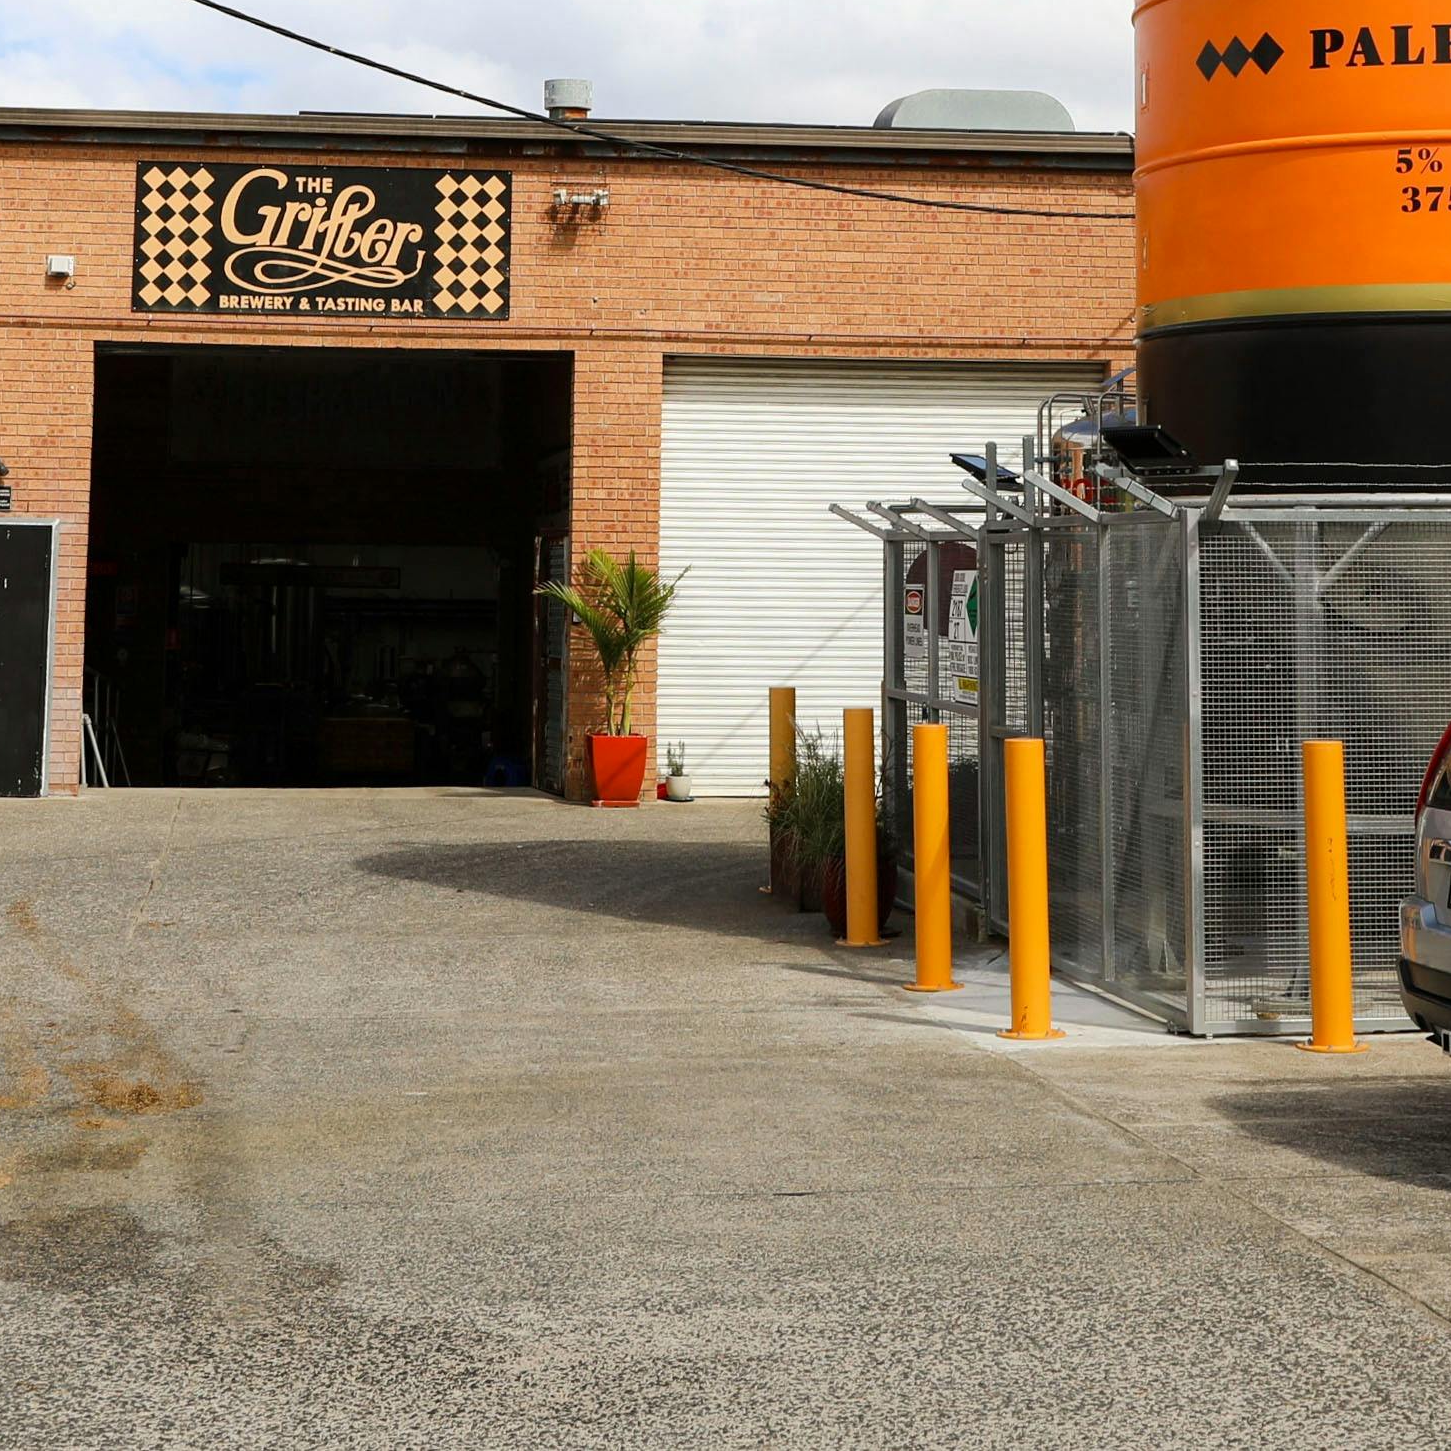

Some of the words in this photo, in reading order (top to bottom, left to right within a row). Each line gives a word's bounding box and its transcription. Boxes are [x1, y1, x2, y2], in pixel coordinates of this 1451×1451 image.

[1394, 147, 1444, 174] 5%
[295, 176, 333, 194] THE
[219, 294, 295, 311] BREWERY
[298, 297, 309, 311] &
[316, 296, 386, 313] TASTING
[391, 298, 424, 313] BAR
